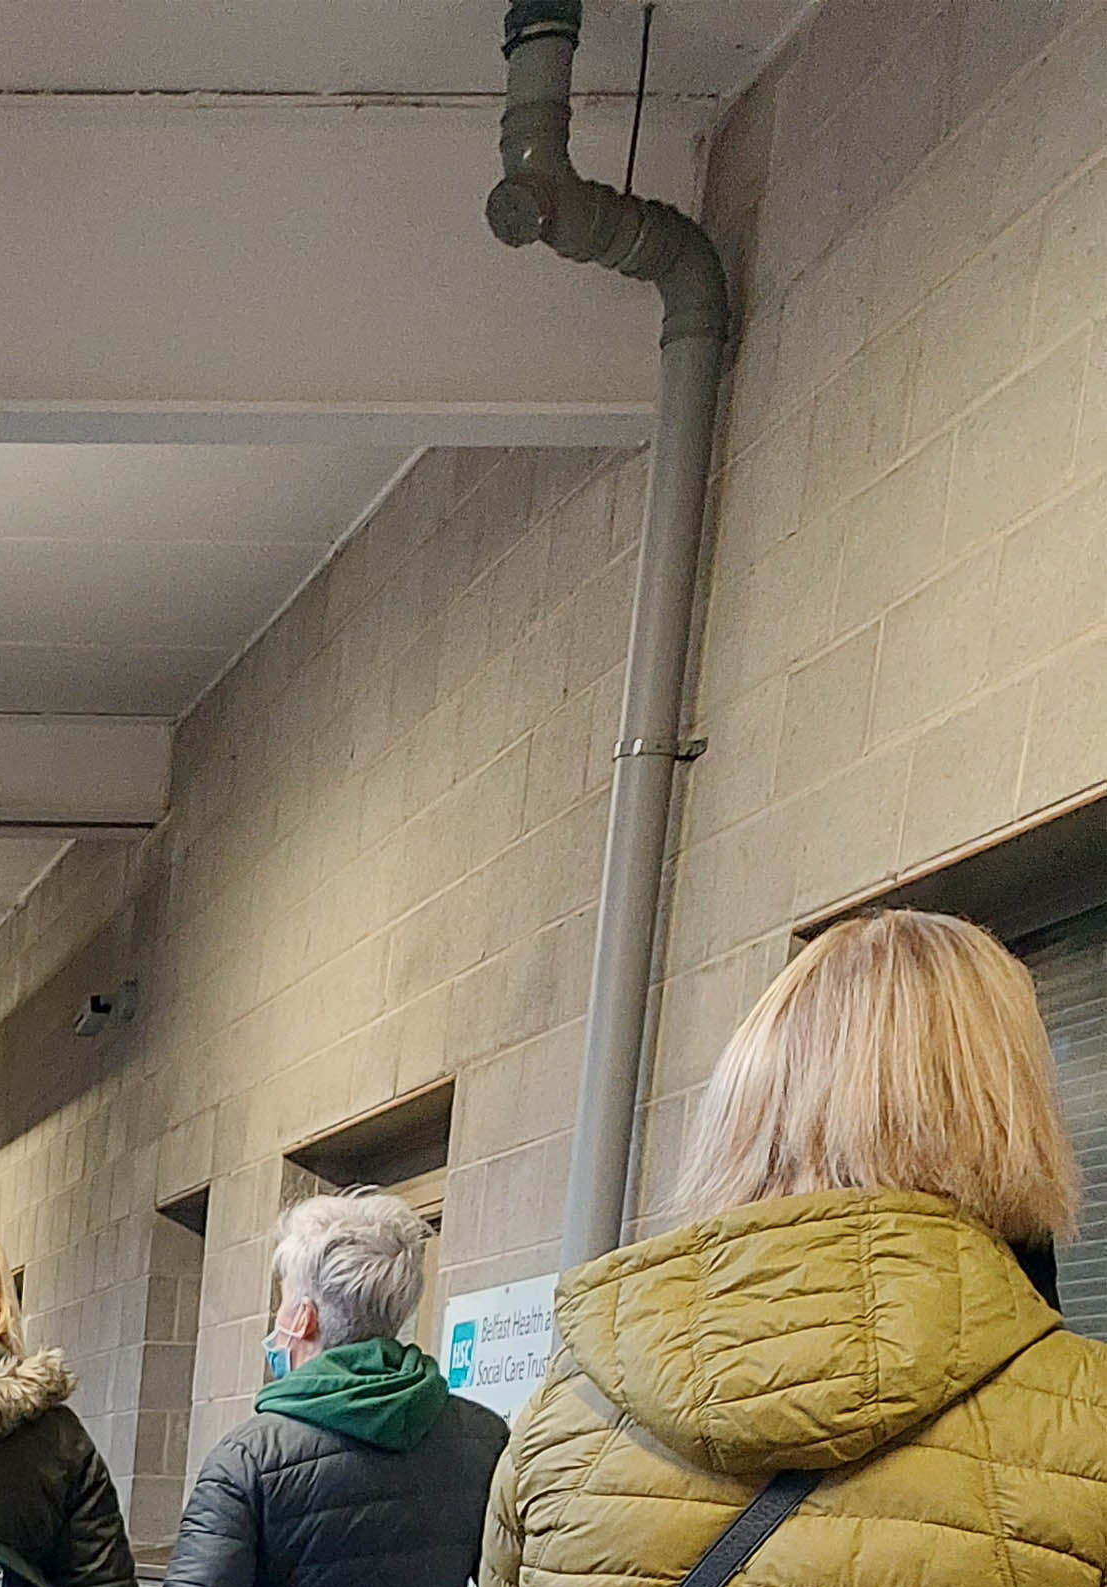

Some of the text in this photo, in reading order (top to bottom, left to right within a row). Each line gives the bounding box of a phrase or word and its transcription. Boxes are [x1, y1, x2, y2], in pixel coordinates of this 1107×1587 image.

[481, 1312, 510, 1343] Belfast
[512, 1304, 544, 1337] Health
[452, 1341, 473, 1370] HSC
[476, 1355, 502, 1386] Social
[505, 1355, 525, 1381] Care
